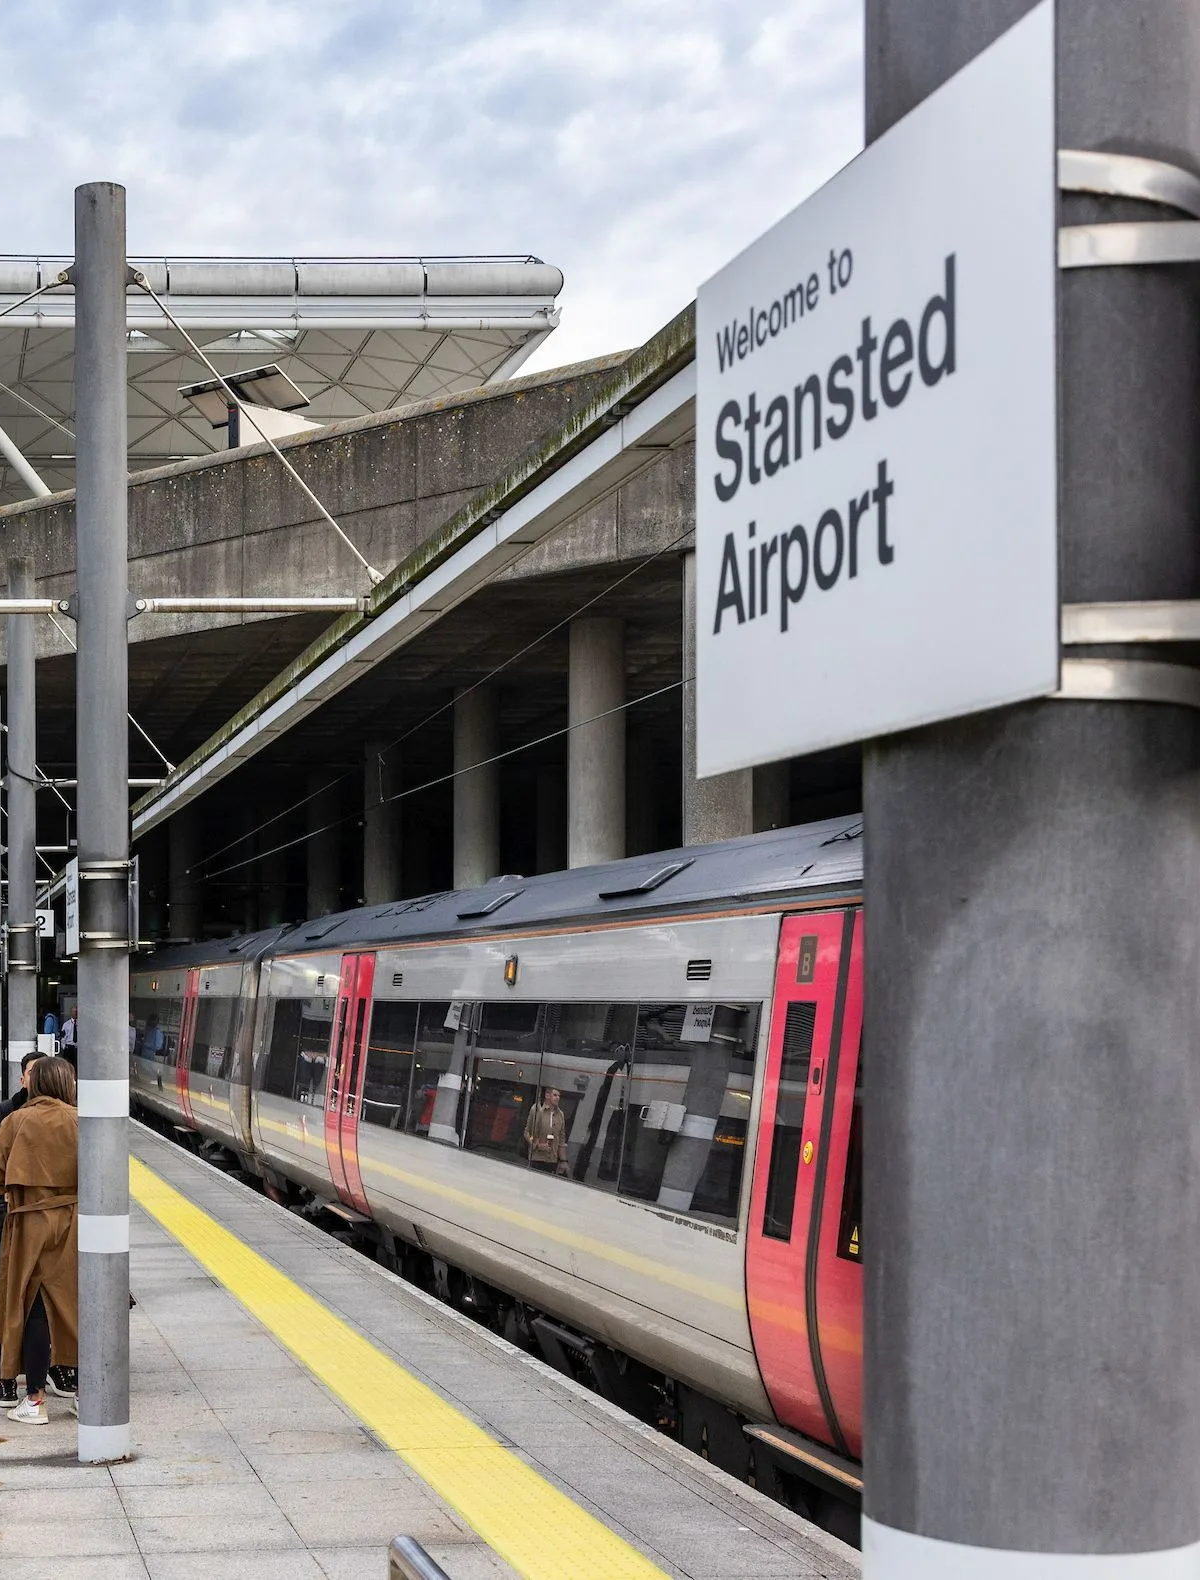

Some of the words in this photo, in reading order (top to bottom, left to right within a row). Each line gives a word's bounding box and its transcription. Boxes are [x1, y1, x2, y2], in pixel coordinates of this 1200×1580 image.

[714, 253, 956, 503] Stansted
[716, 273, 819, 373] Welcome
[827, 248, 853, 295] to
[712, 460, 895, 634] Airport
[36, 915, 46, 931] 2
